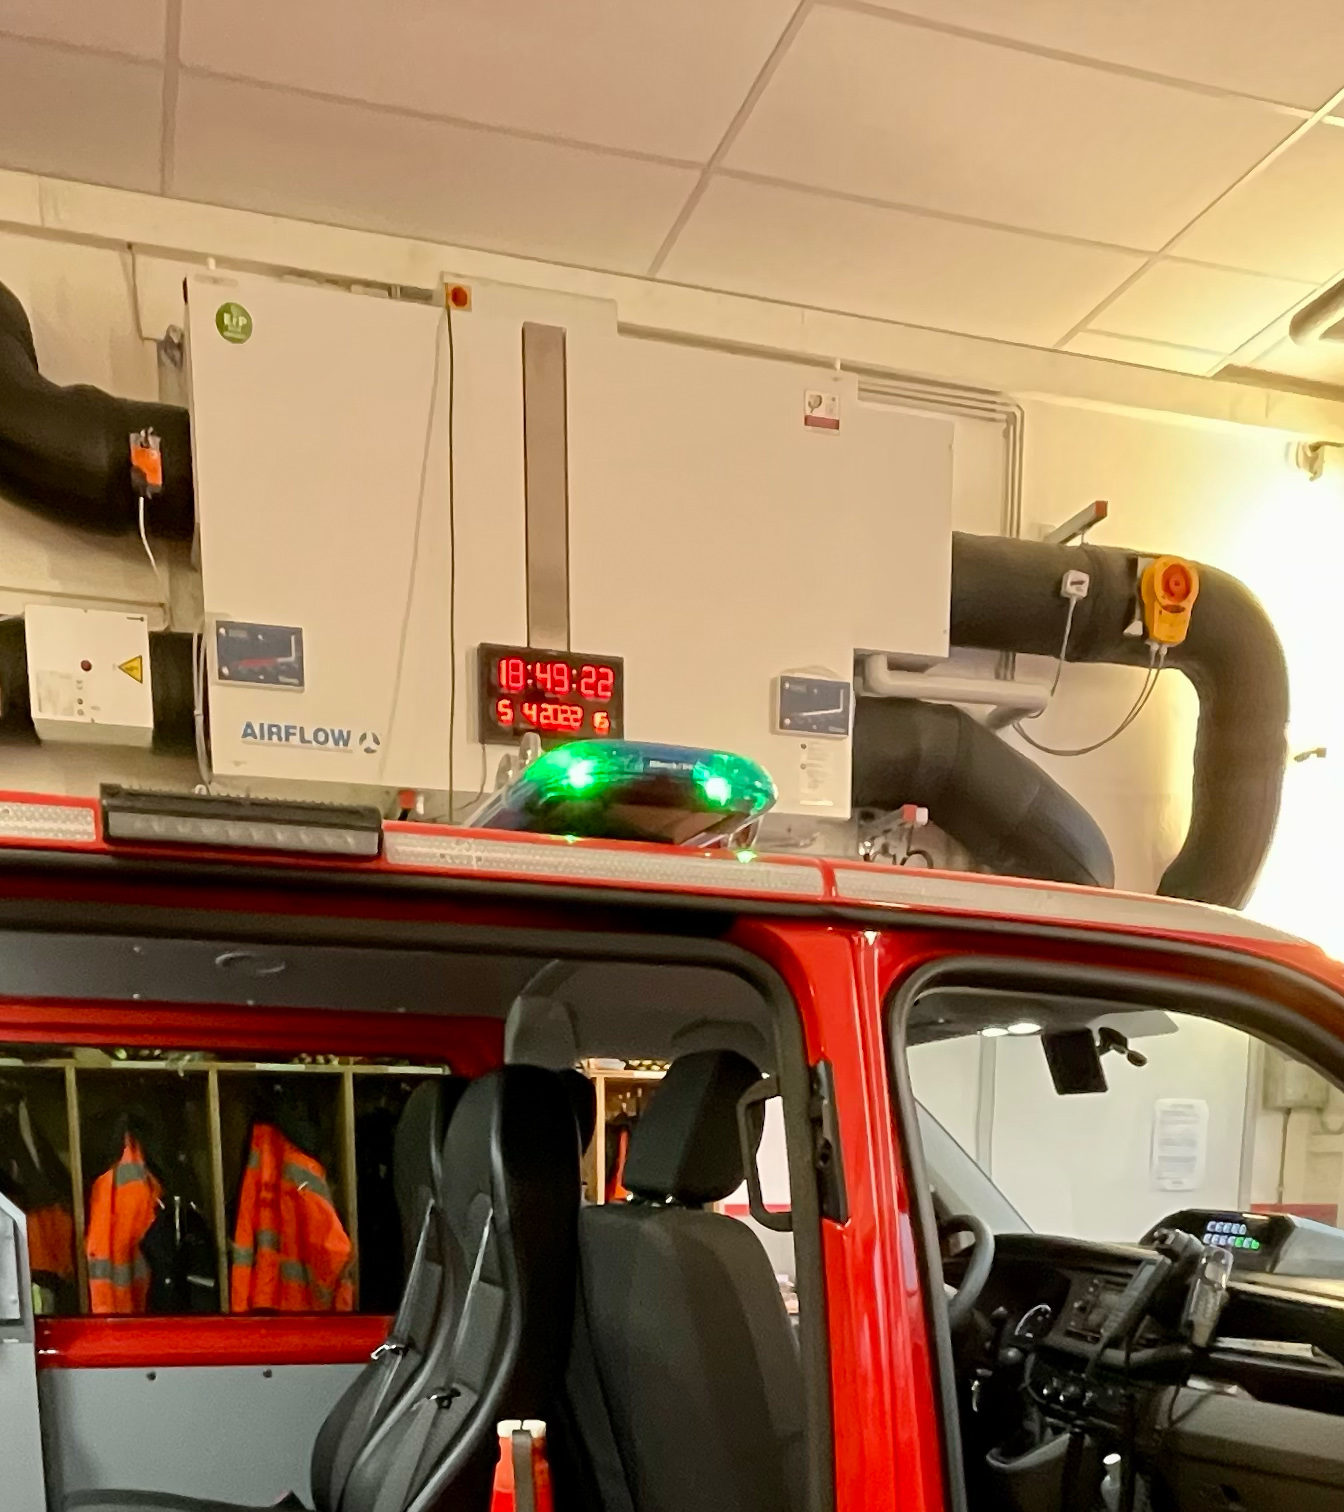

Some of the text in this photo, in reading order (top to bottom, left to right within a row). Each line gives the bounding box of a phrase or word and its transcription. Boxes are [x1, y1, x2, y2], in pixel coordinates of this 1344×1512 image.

[499, 658, 614, 698] 18:49:22
[497, 699, 513, 722] 5
[241, 721, 352, 747] AIRFLOW
